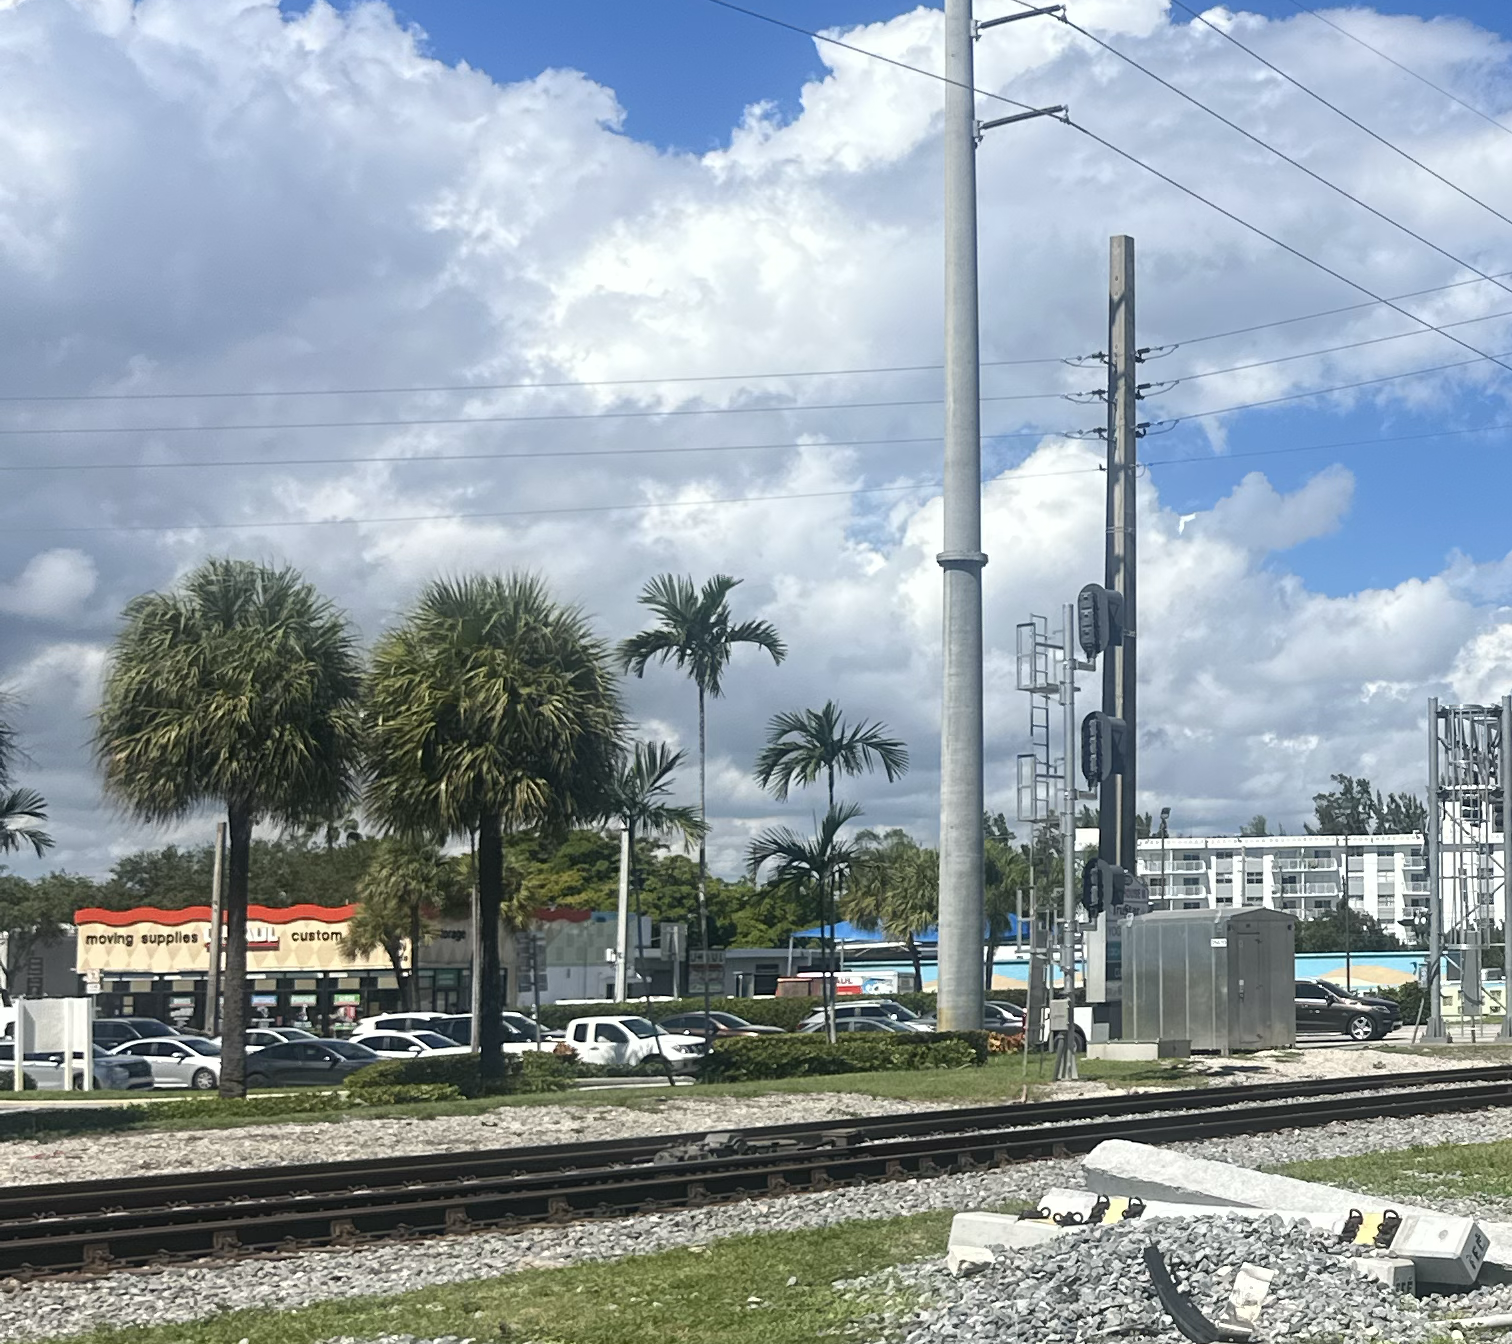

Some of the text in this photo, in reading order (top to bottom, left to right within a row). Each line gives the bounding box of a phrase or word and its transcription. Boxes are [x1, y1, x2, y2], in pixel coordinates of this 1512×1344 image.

[85, 931, 198, 947] moving supplies
[291, 930, 343, 943] custom
